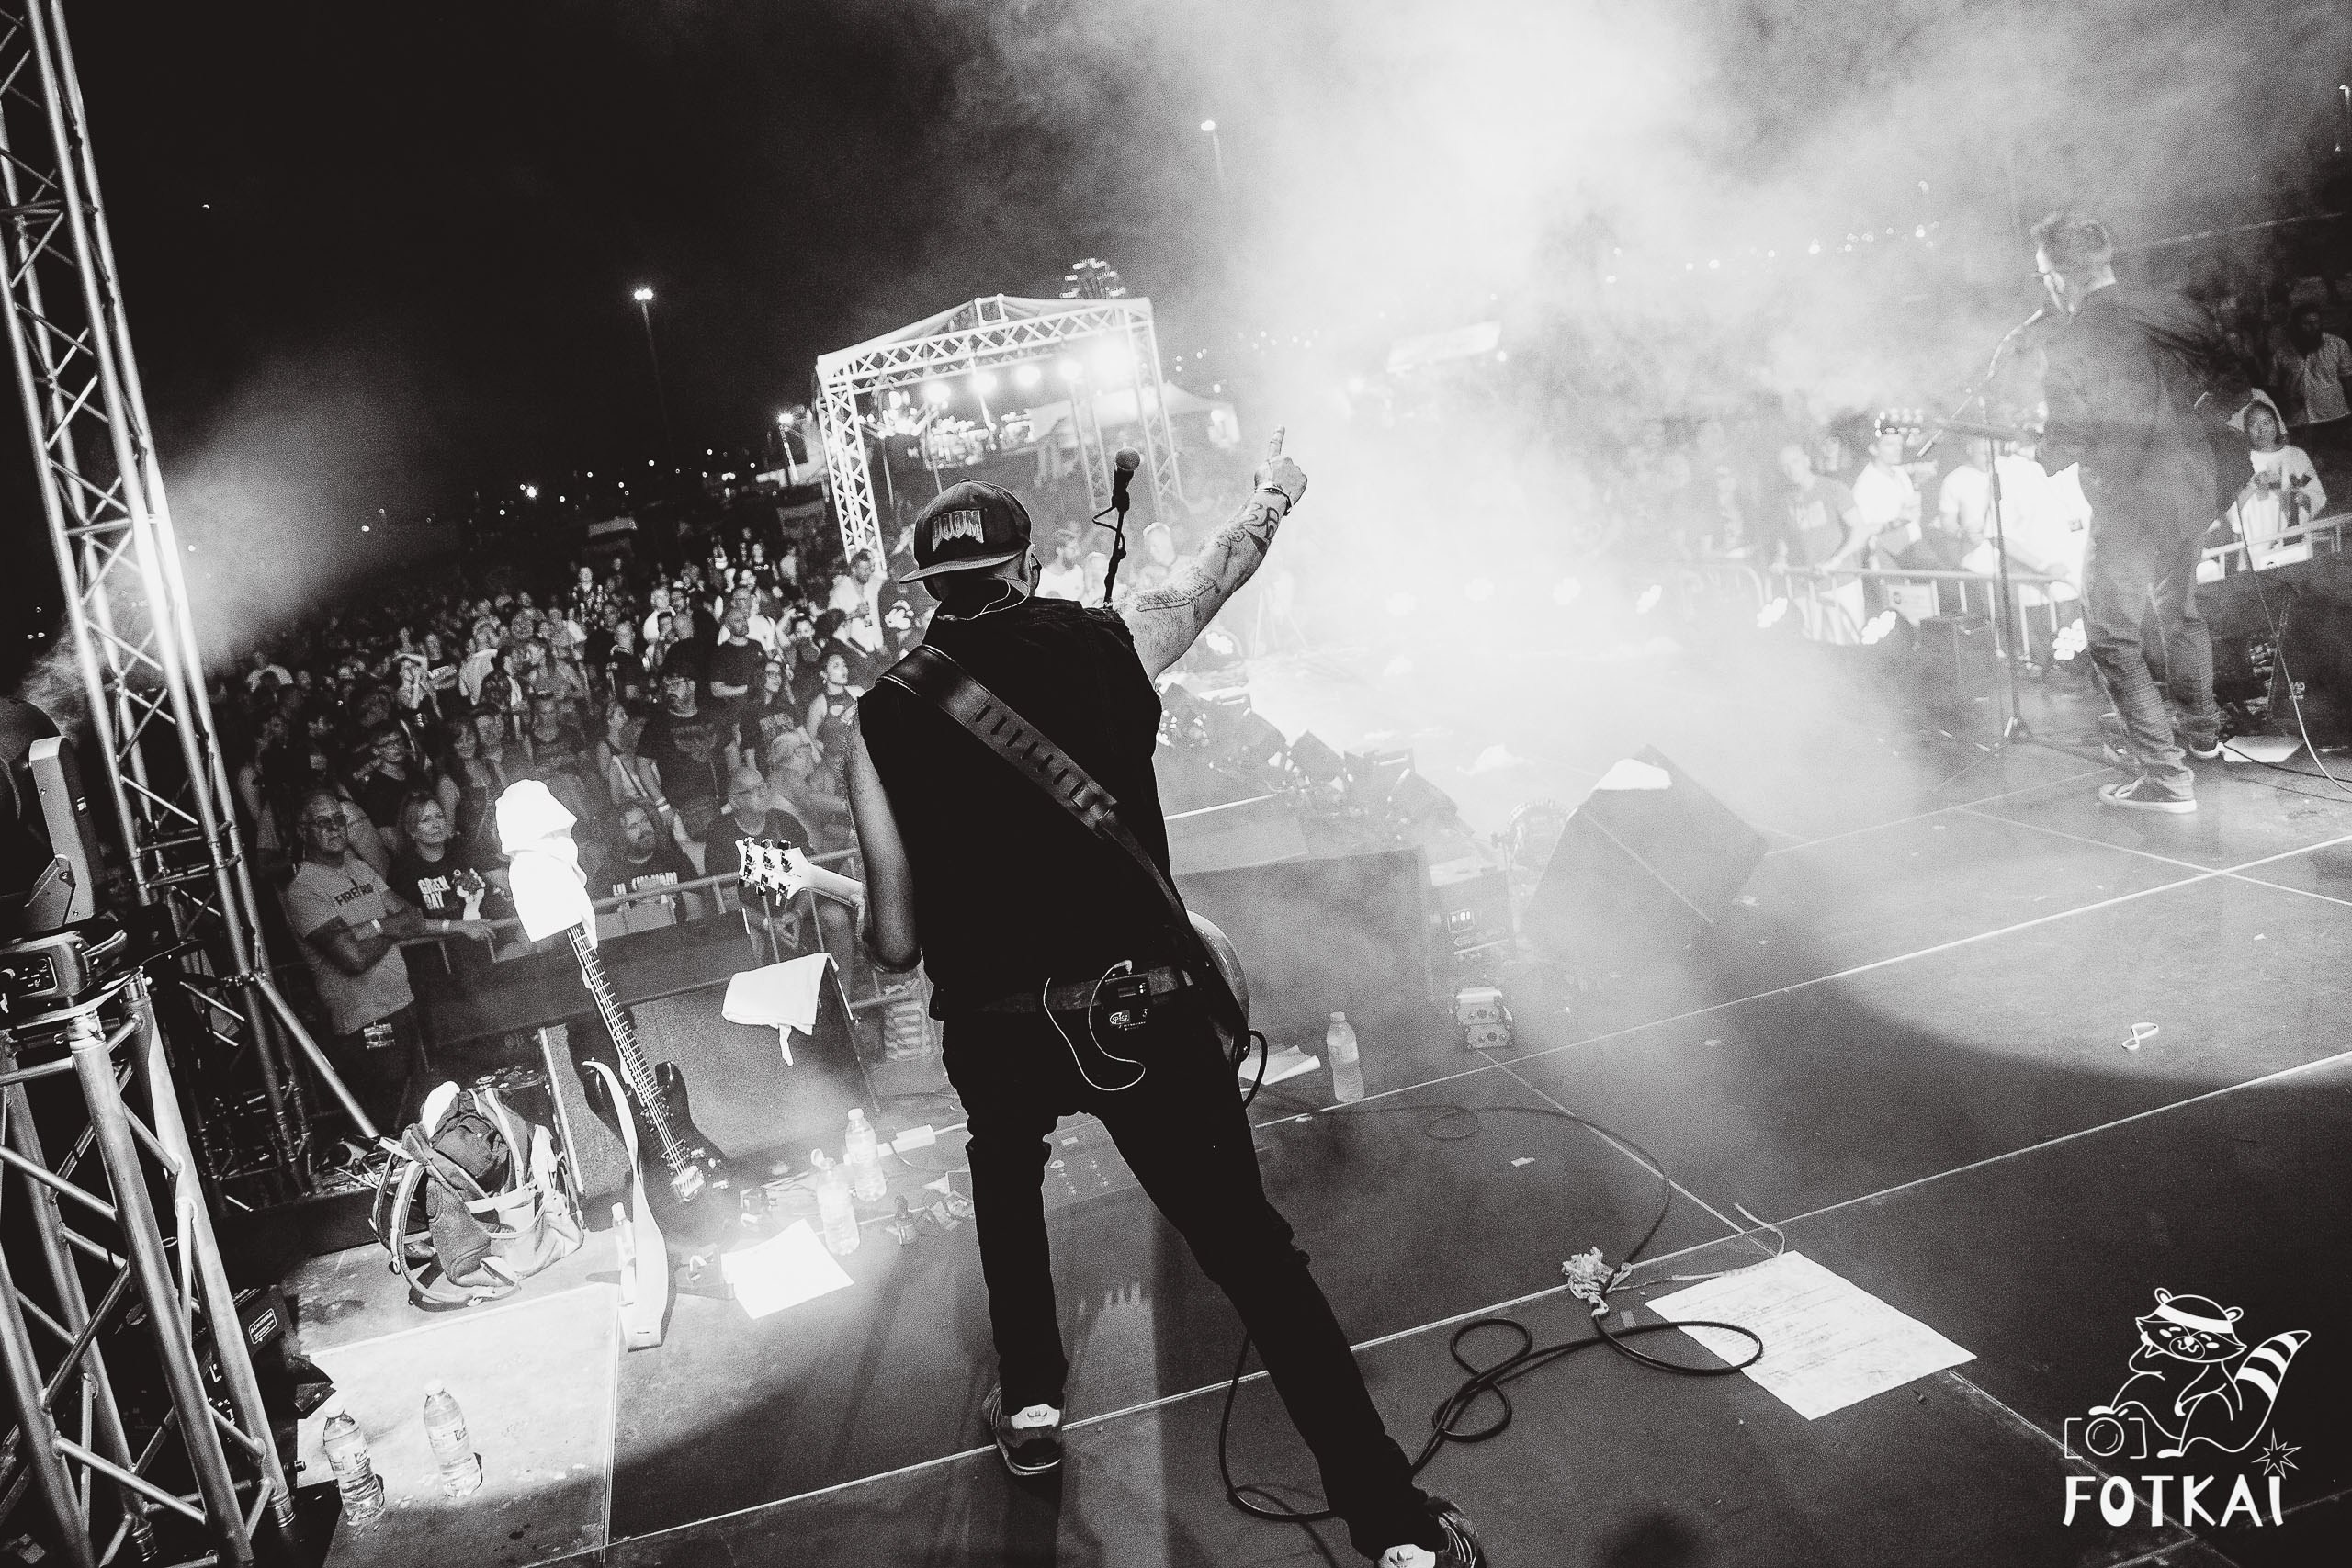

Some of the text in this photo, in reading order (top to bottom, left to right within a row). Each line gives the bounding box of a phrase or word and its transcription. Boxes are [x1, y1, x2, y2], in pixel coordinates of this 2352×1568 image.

[932, 510, 984, 551] DOOM
[418, 875, 451, 895] GREEN
[423, 890, 444, 910] DAY
